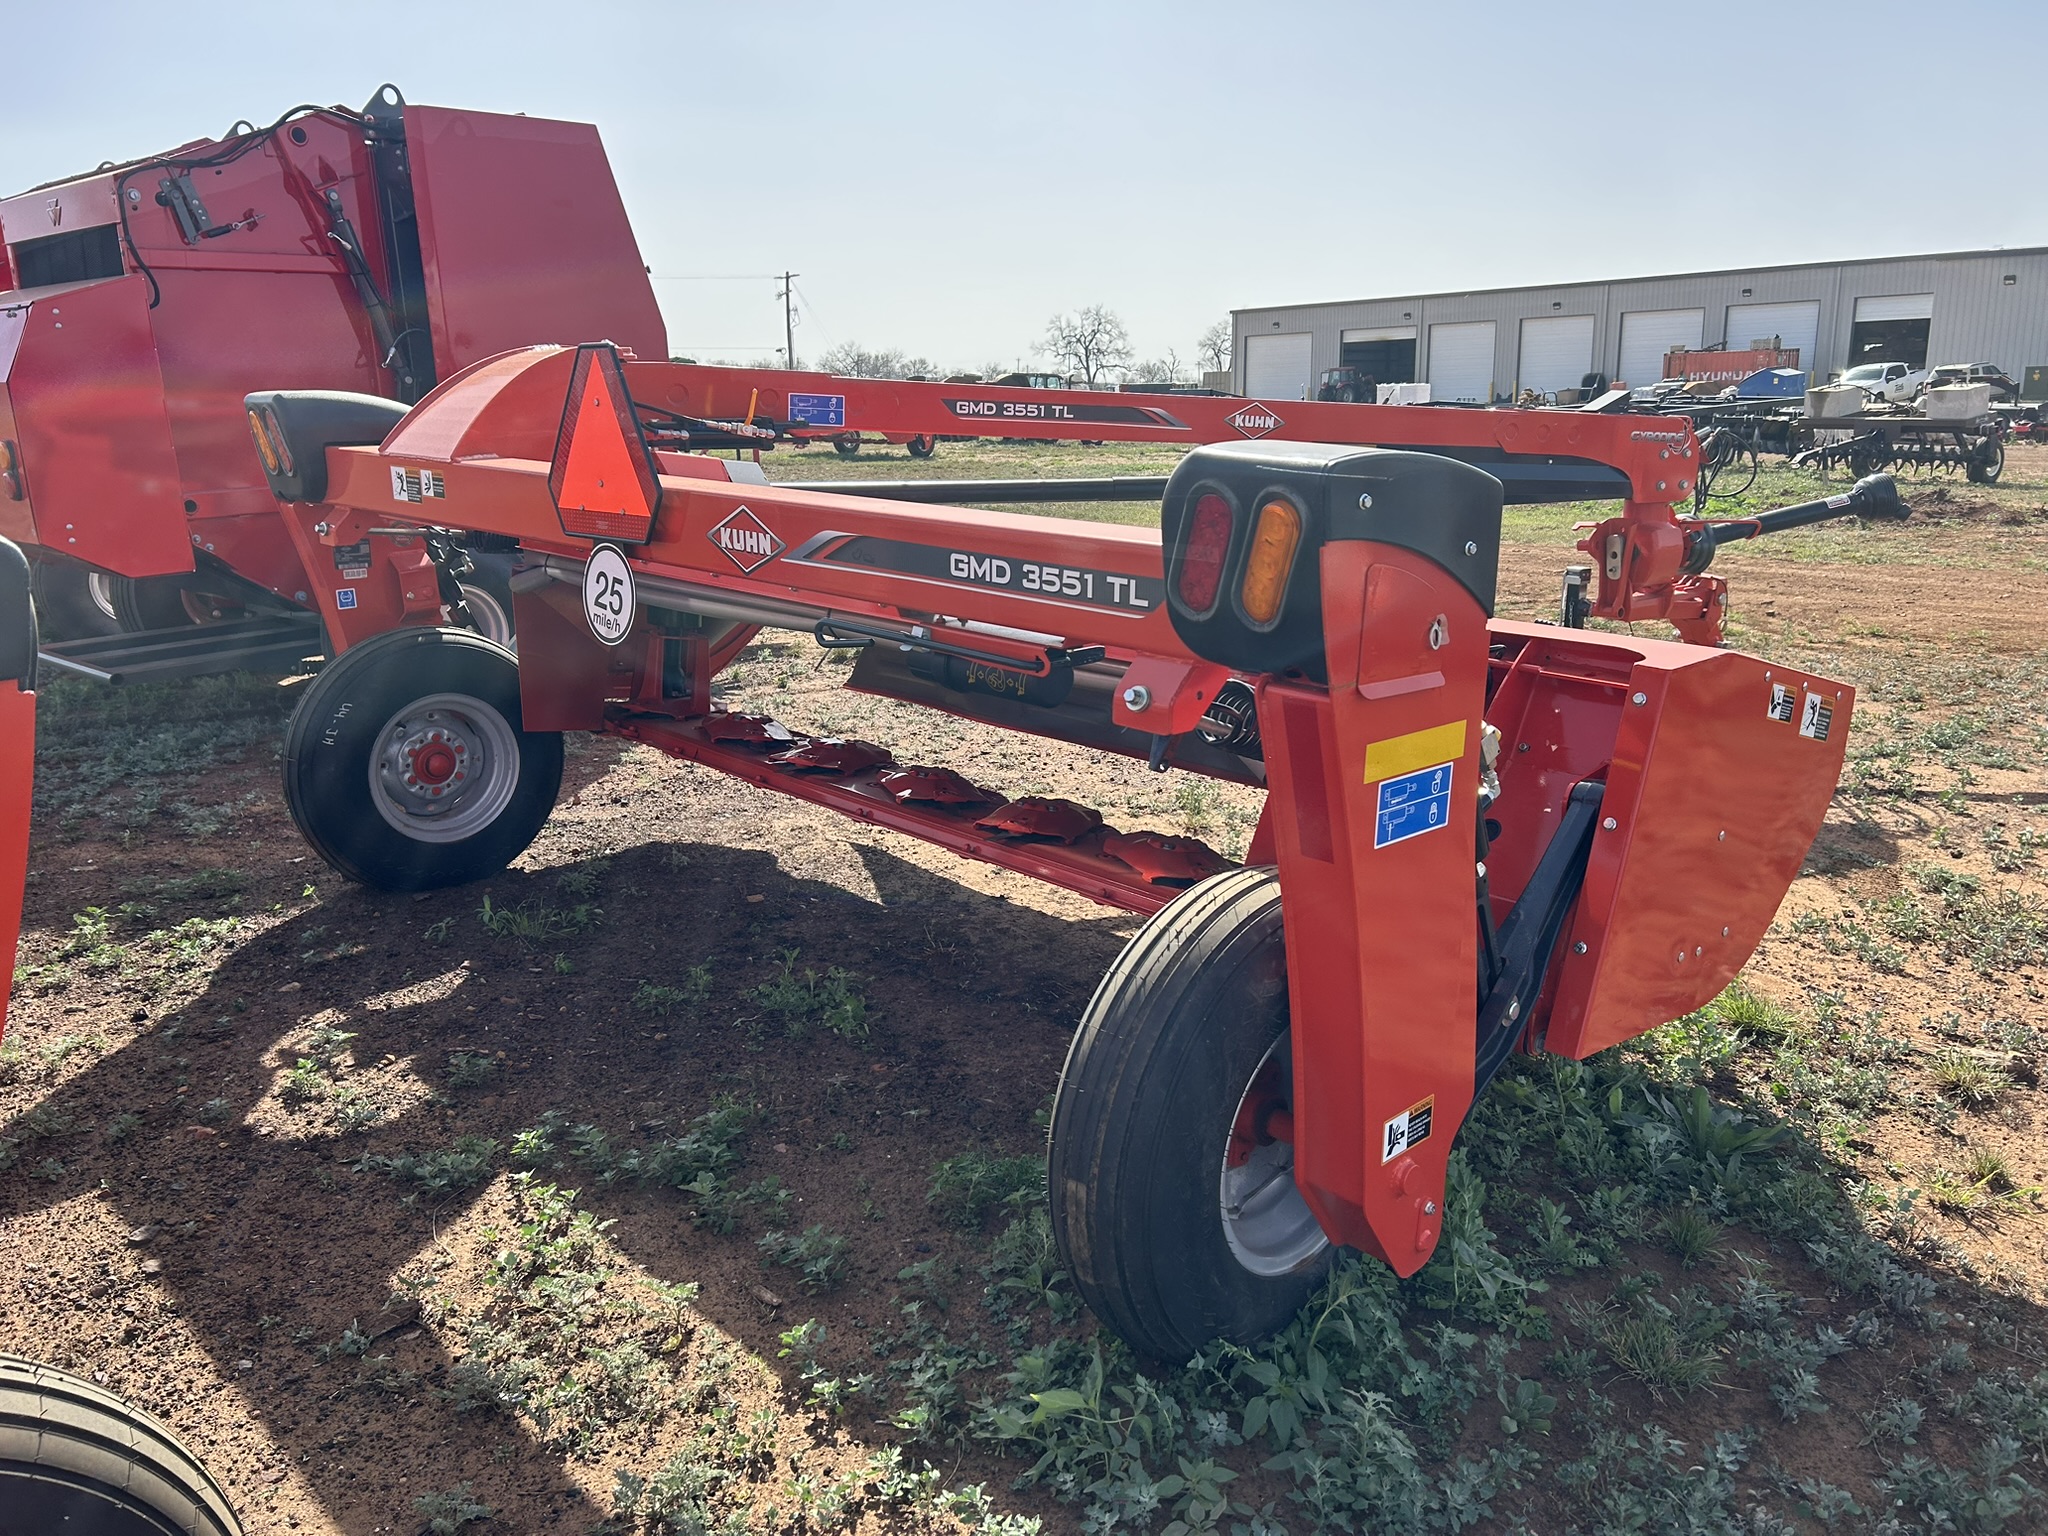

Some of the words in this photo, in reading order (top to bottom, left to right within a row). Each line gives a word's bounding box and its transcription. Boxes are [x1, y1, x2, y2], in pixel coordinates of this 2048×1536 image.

[1689, 370, 1753, 381] HYUNDA
[956, 401, 997, 415] GMD
[1002, 403, 1045, 417] 3551
[1051, 405, 1074, 418] TL
[1234, 414, 1275, 428] KUHN
[720, 526, 772, 556] KUHN
[950, 553, 1011, 585] GMD
[1022, 563, 1093, 599] 3551
[1106, 575, 1149, 608] TL
[593, 570, 623, 616] 25
[592, 612, 621, 634] mile/h
